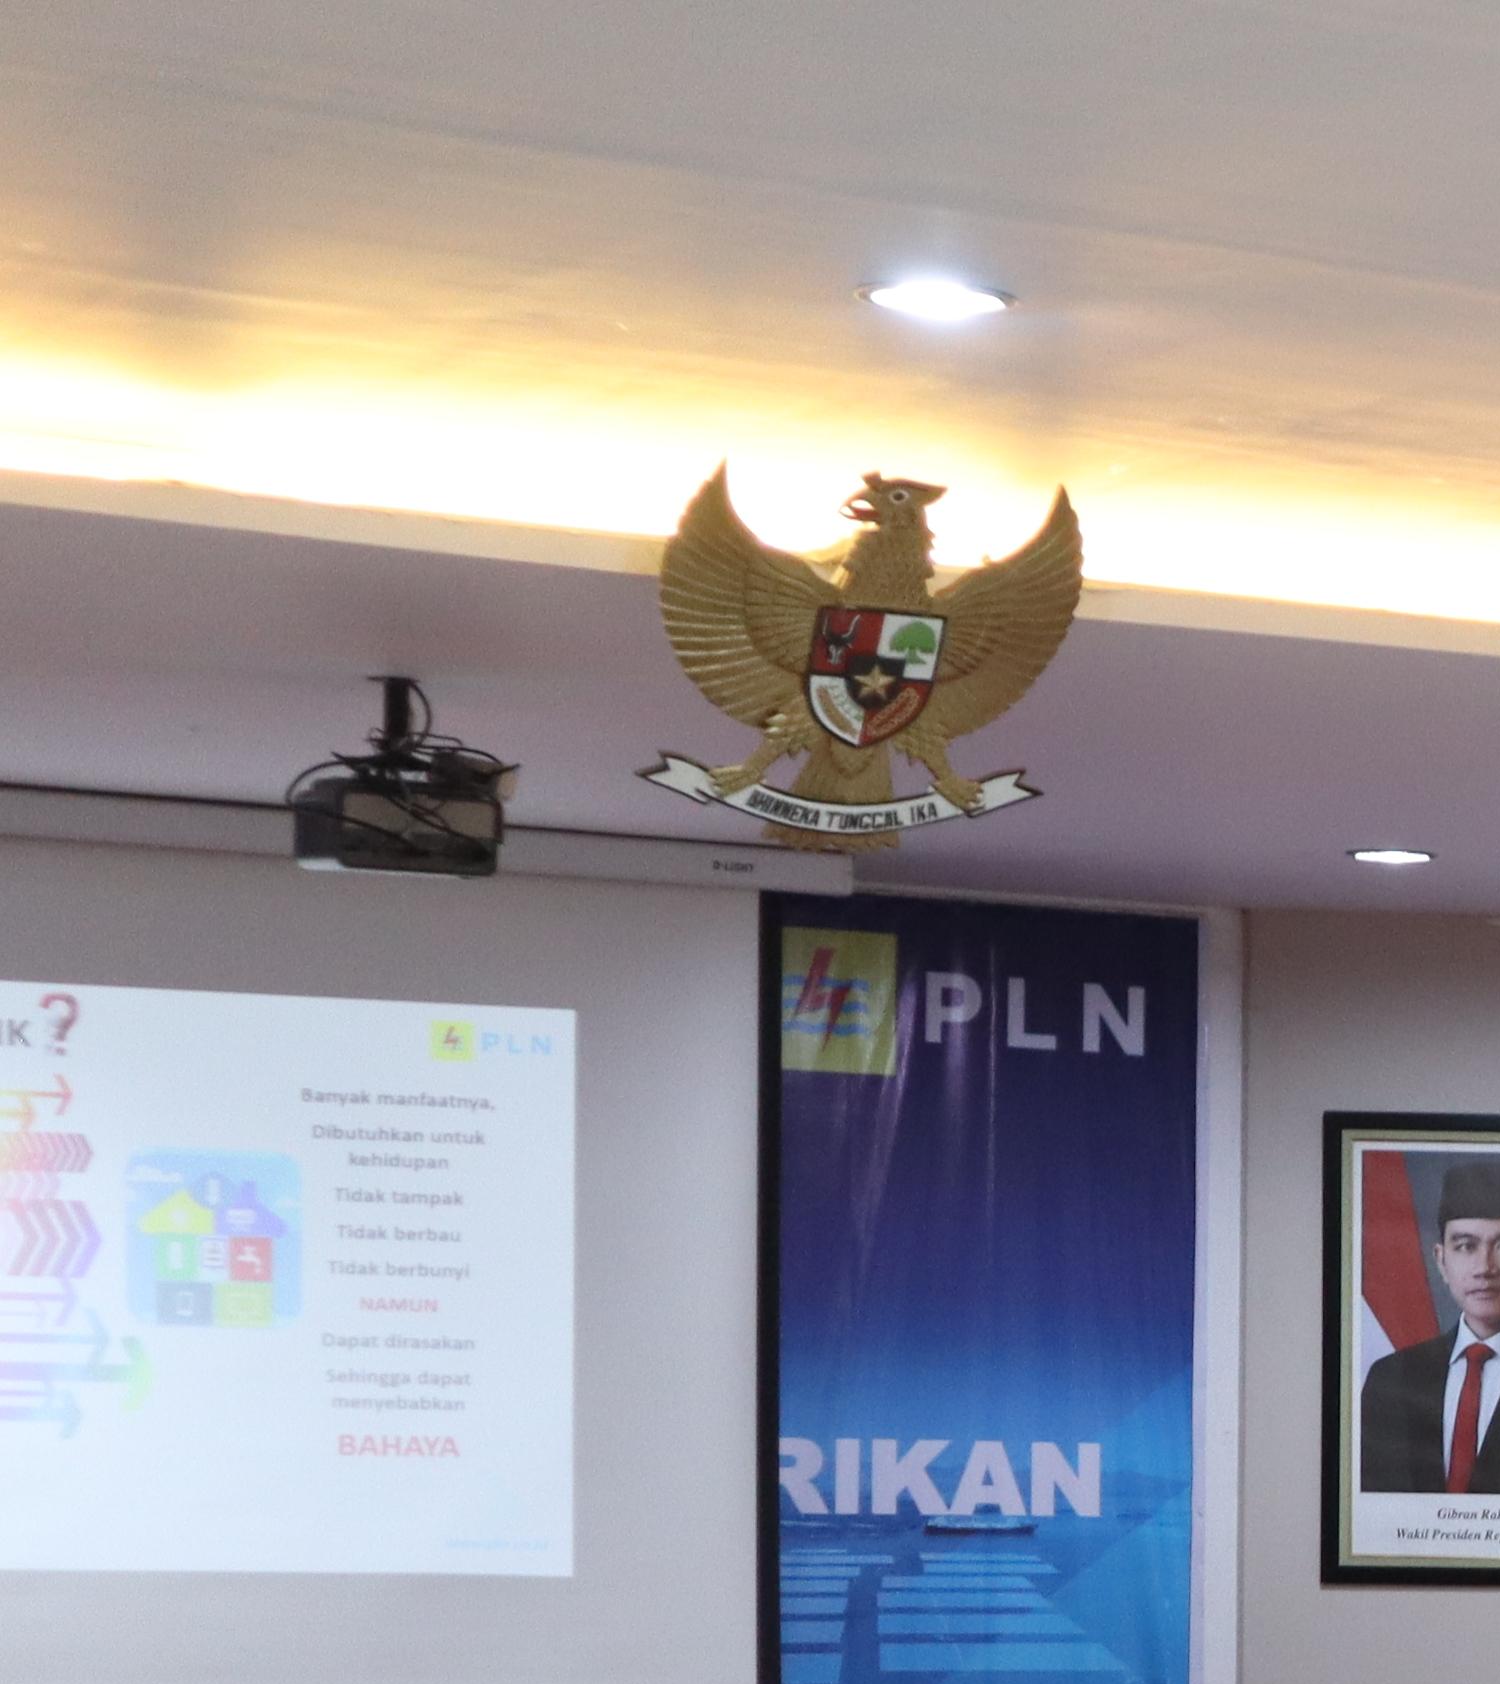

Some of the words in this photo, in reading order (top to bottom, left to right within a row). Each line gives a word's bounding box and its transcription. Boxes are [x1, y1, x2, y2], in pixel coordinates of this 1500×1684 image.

[910, 801, 939, 824] IKA
[925, 971, 1145, 1056] PLN
[481, 1031, 552, 1055] PLN
[301, 1087, 370, 1107] Banyak
[377, 1091, 496, 1111] manfaatnya,
[312, 1124, 424, 1143] Dibutuhkan
[431, 1130, 486, 1145] untuk
[348, 1152, 449, 1171] kehidupan
[335, 1187, 384, 1203] Tidak
[392, 1190, 464, 1207] tampak
[337, 1225, 387, 1240] Tidak
[394, 1226, 461, 1243] berbau
[328, 1260, 379, 1276] Tidak
[385, 1262, 470, 1280] berbunyi
[358, 1297, 439, 1313] NAMUN
[321, 1333, 379, 1351] Dapat
[384, 1334, 475, 1351] dirasakan
[324, 1369, 411, 1388] Sehingga
[417, 1370, 471, 1388] dapat
[331, 1396, 466, 1412] menyebabkan
[337, 1434, 460, 1458] BAHAYA
[1437, 1507, 1478, 1521] Gibran
[1396, 1527, 1429, 1540] Wakil
[1432, 1528, 1481, 1542] Presiden
